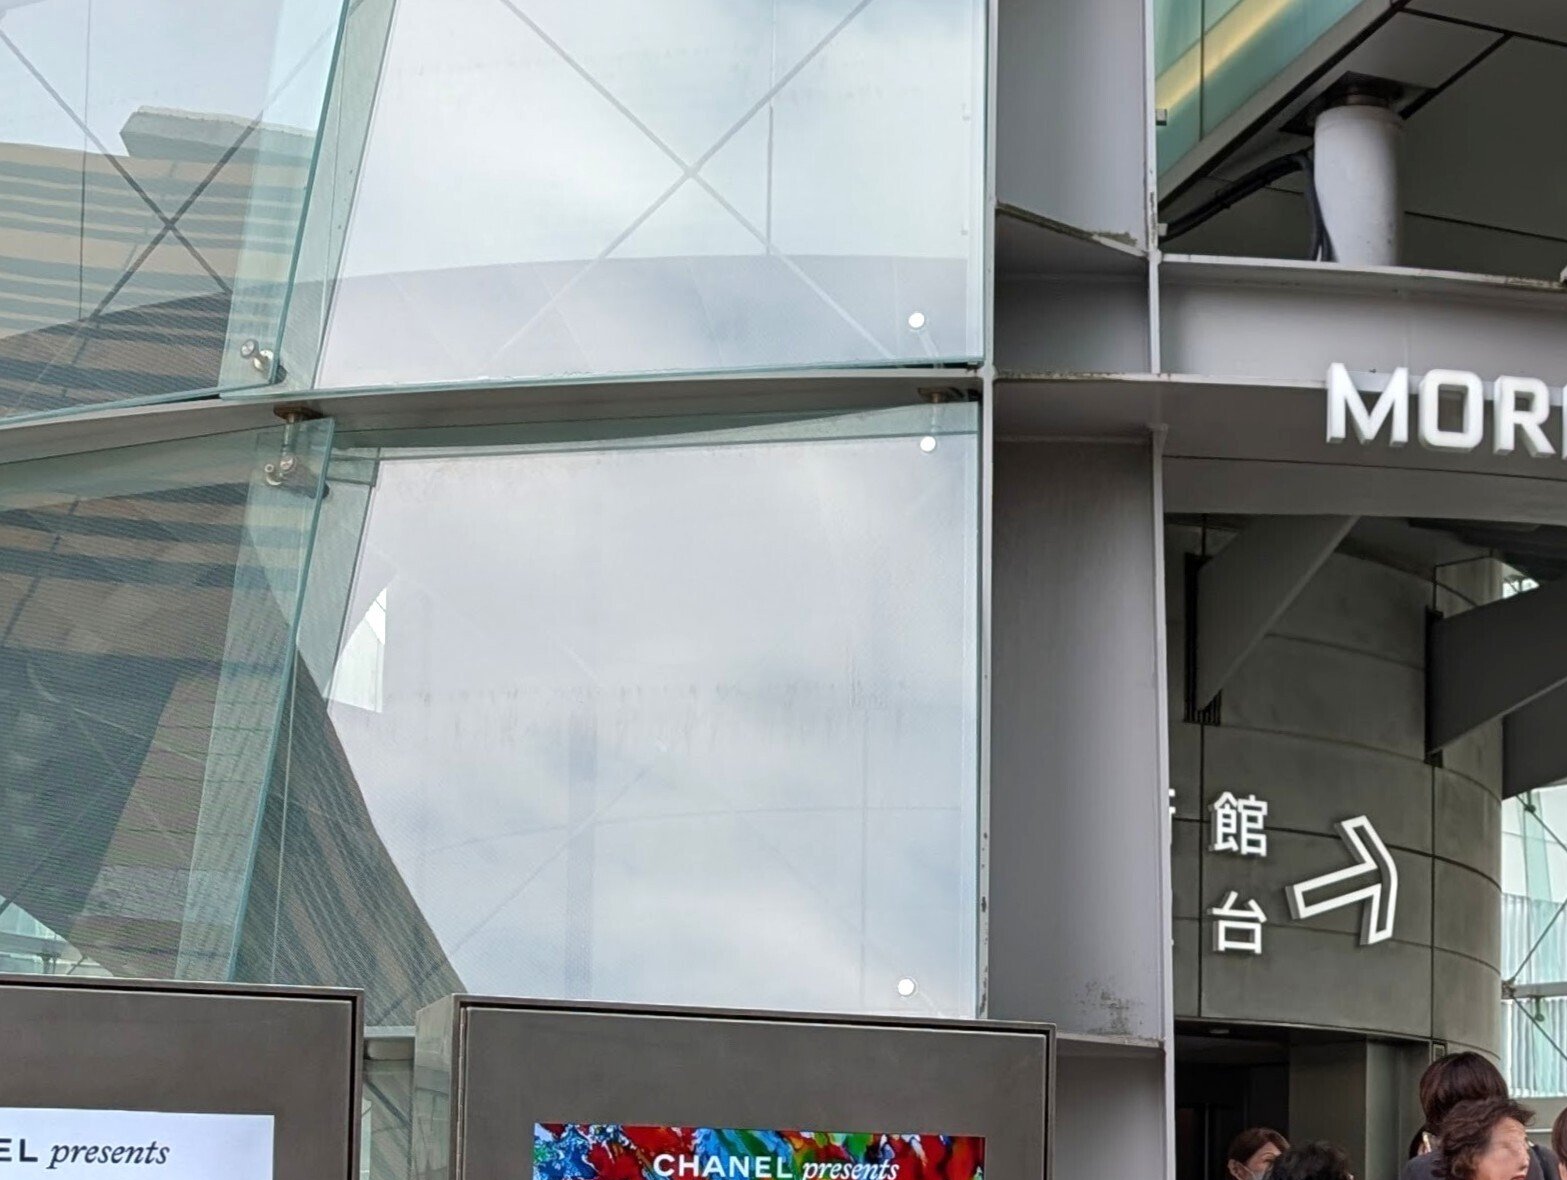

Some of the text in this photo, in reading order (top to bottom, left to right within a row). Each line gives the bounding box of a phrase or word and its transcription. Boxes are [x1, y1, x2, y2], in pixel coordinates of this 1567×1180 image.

[1207, 890, 1268, 954] 台
[46, 1138, 170, 1170] presents
[653, 1154, 793, 1179] CHANEL
